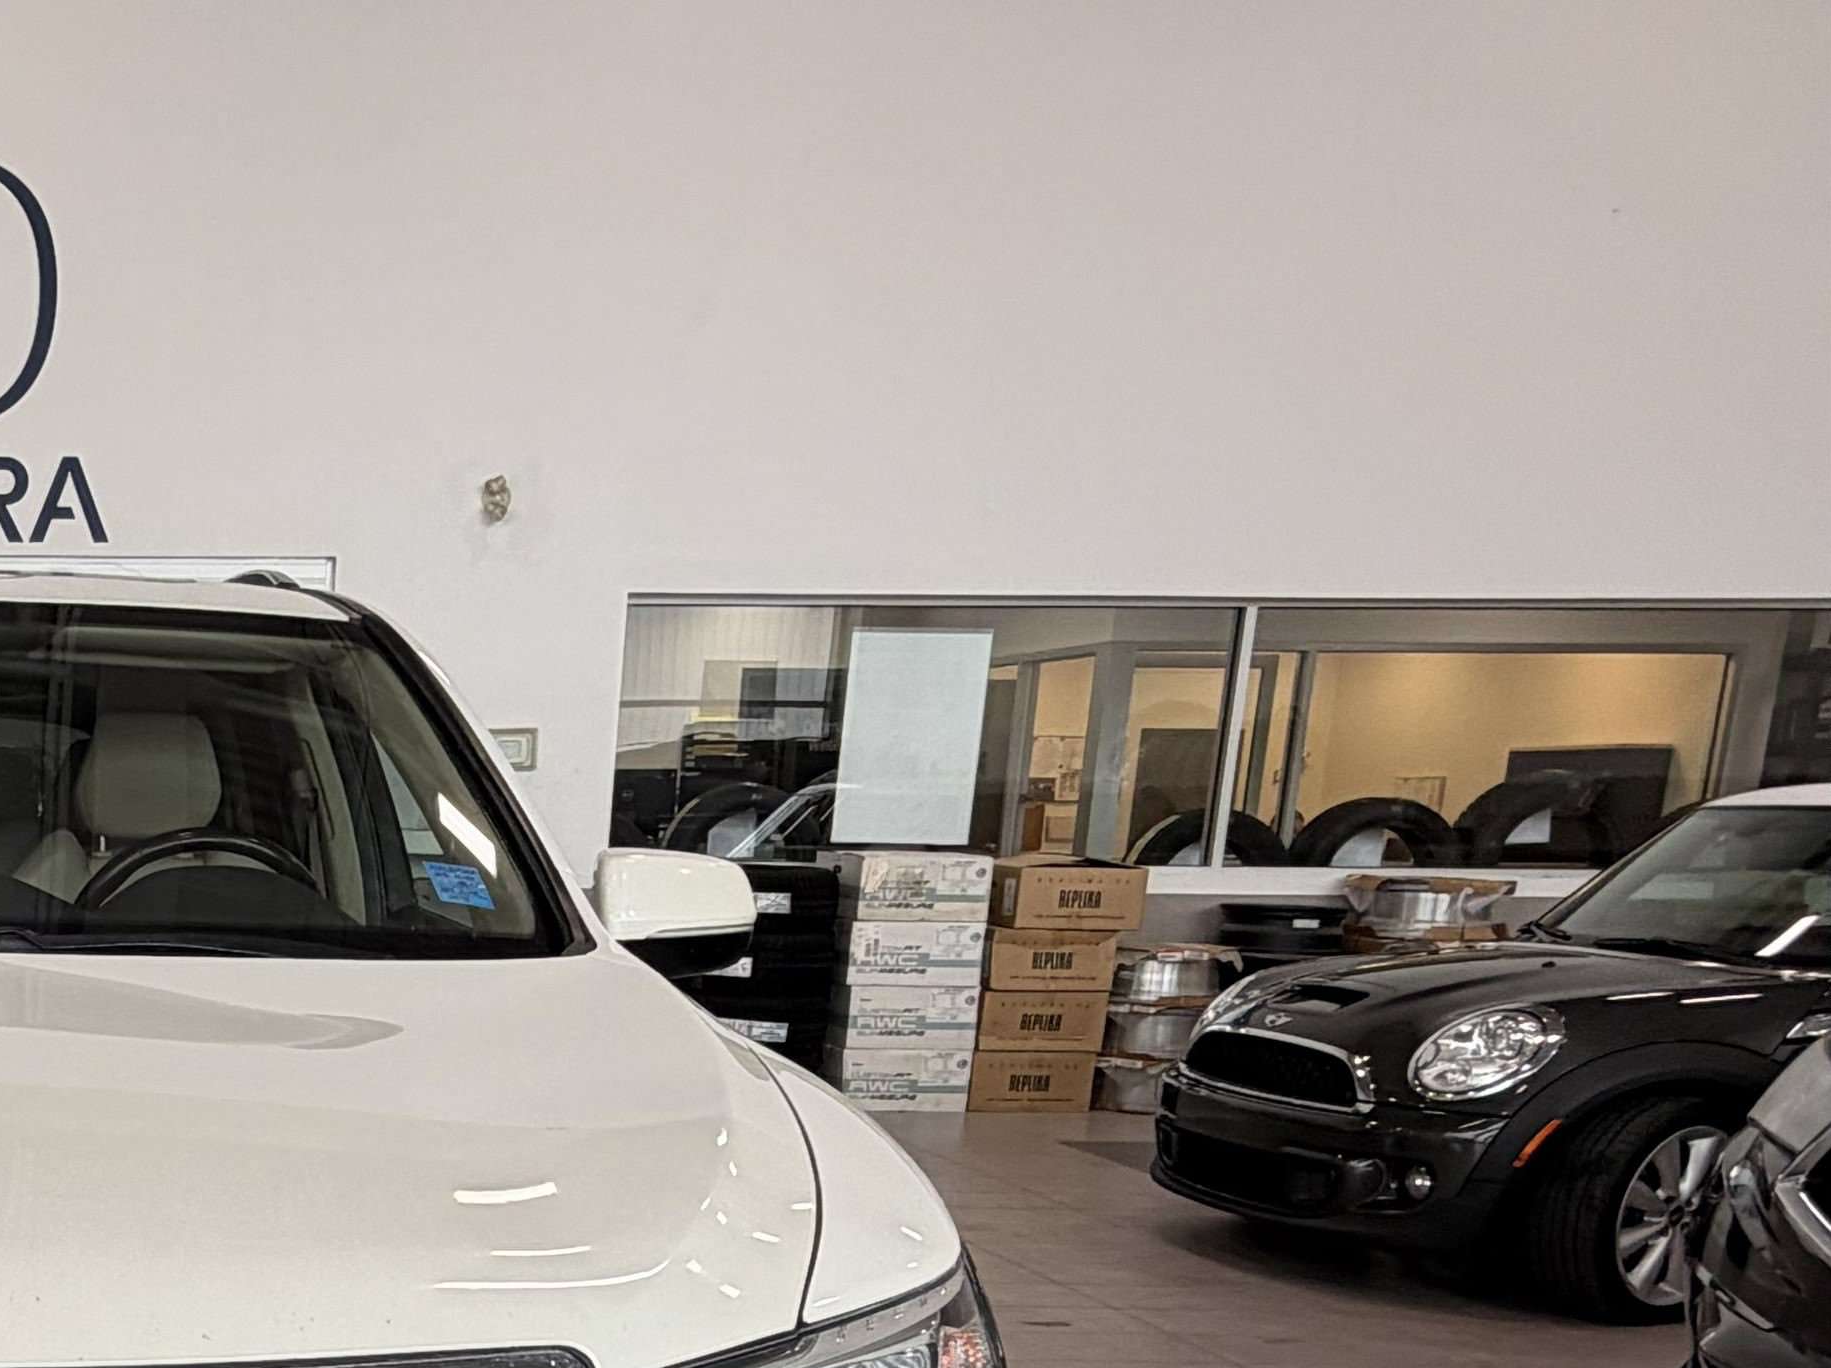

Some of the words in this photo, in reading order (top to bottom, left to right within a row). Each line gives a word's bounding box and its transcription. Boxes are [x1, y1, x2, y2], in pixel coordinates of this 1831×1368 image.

[1058, 889, 1102, 909] REPLIKA
[1031, 951, 1074, 970] REPLIKA
[1019, 1013, 1062, 1032] REPLIKA
[1008, 1074, 1051, 1093] REPLIKA
